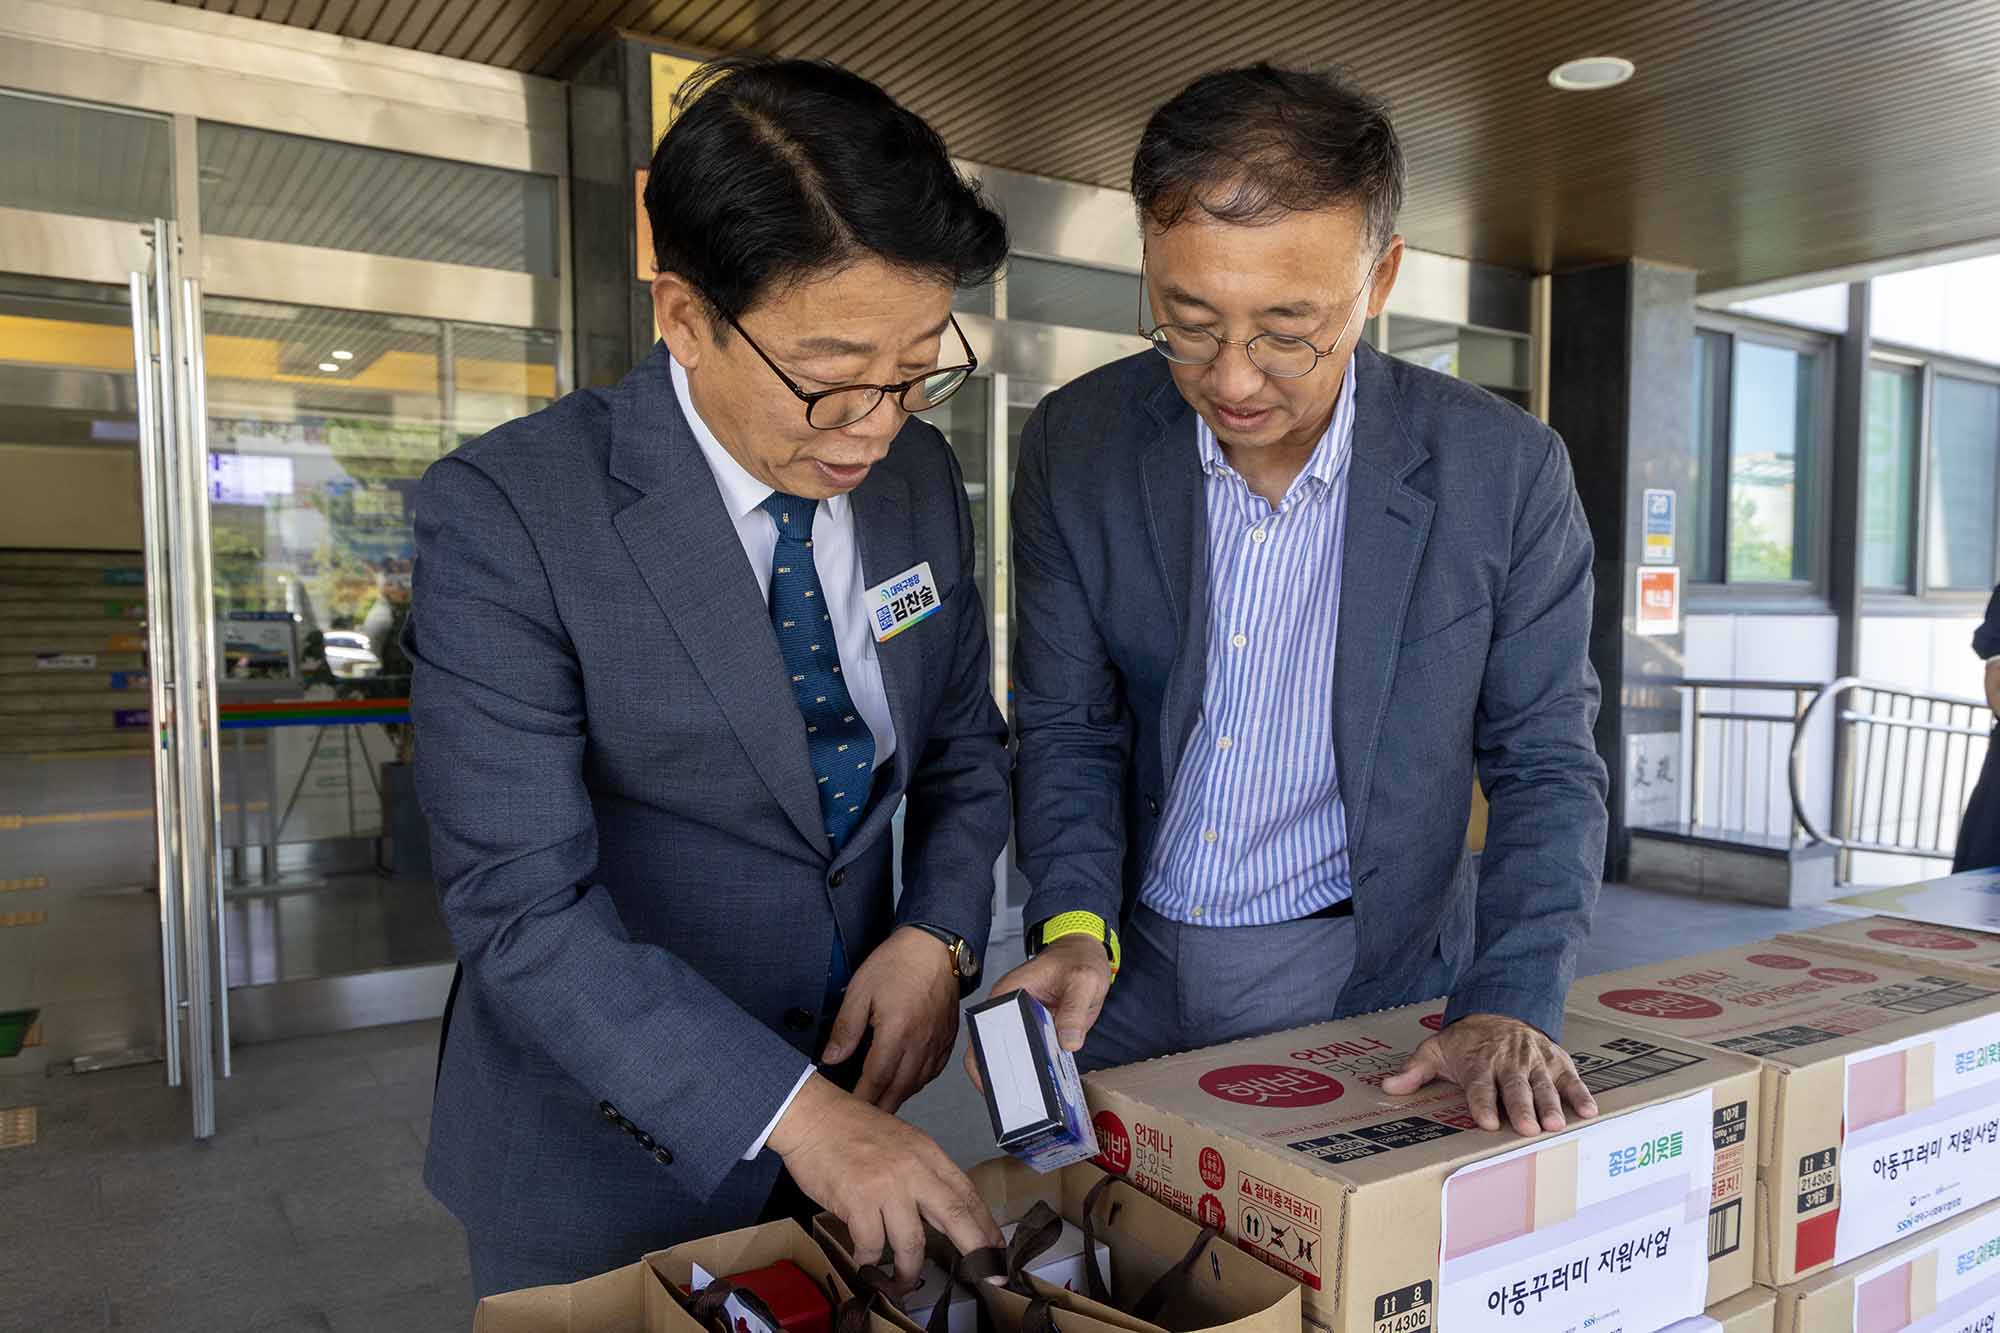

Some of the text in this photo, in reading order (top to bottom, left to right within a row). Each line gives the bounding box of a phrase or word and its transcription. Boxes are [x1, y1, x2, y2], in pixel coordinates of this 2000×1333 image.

[891, 585, 935, 622] 김찬술
[1290, 1036, 1392, 1066] 언제나
[1216, 1069, 1330, 1103] 햇반
[1135, 1122, 1173, 1159] 언제나
[1873, 1118, 1999, 1180] 아동꾸러미 지원사업
[1136, 1147, 1173, 1183] 맛있는
[1255, 1183, 1318, 1225] 절대충격금지!
[1488, 1227, 1671, 1315] 아동꾸러미 지원사업
